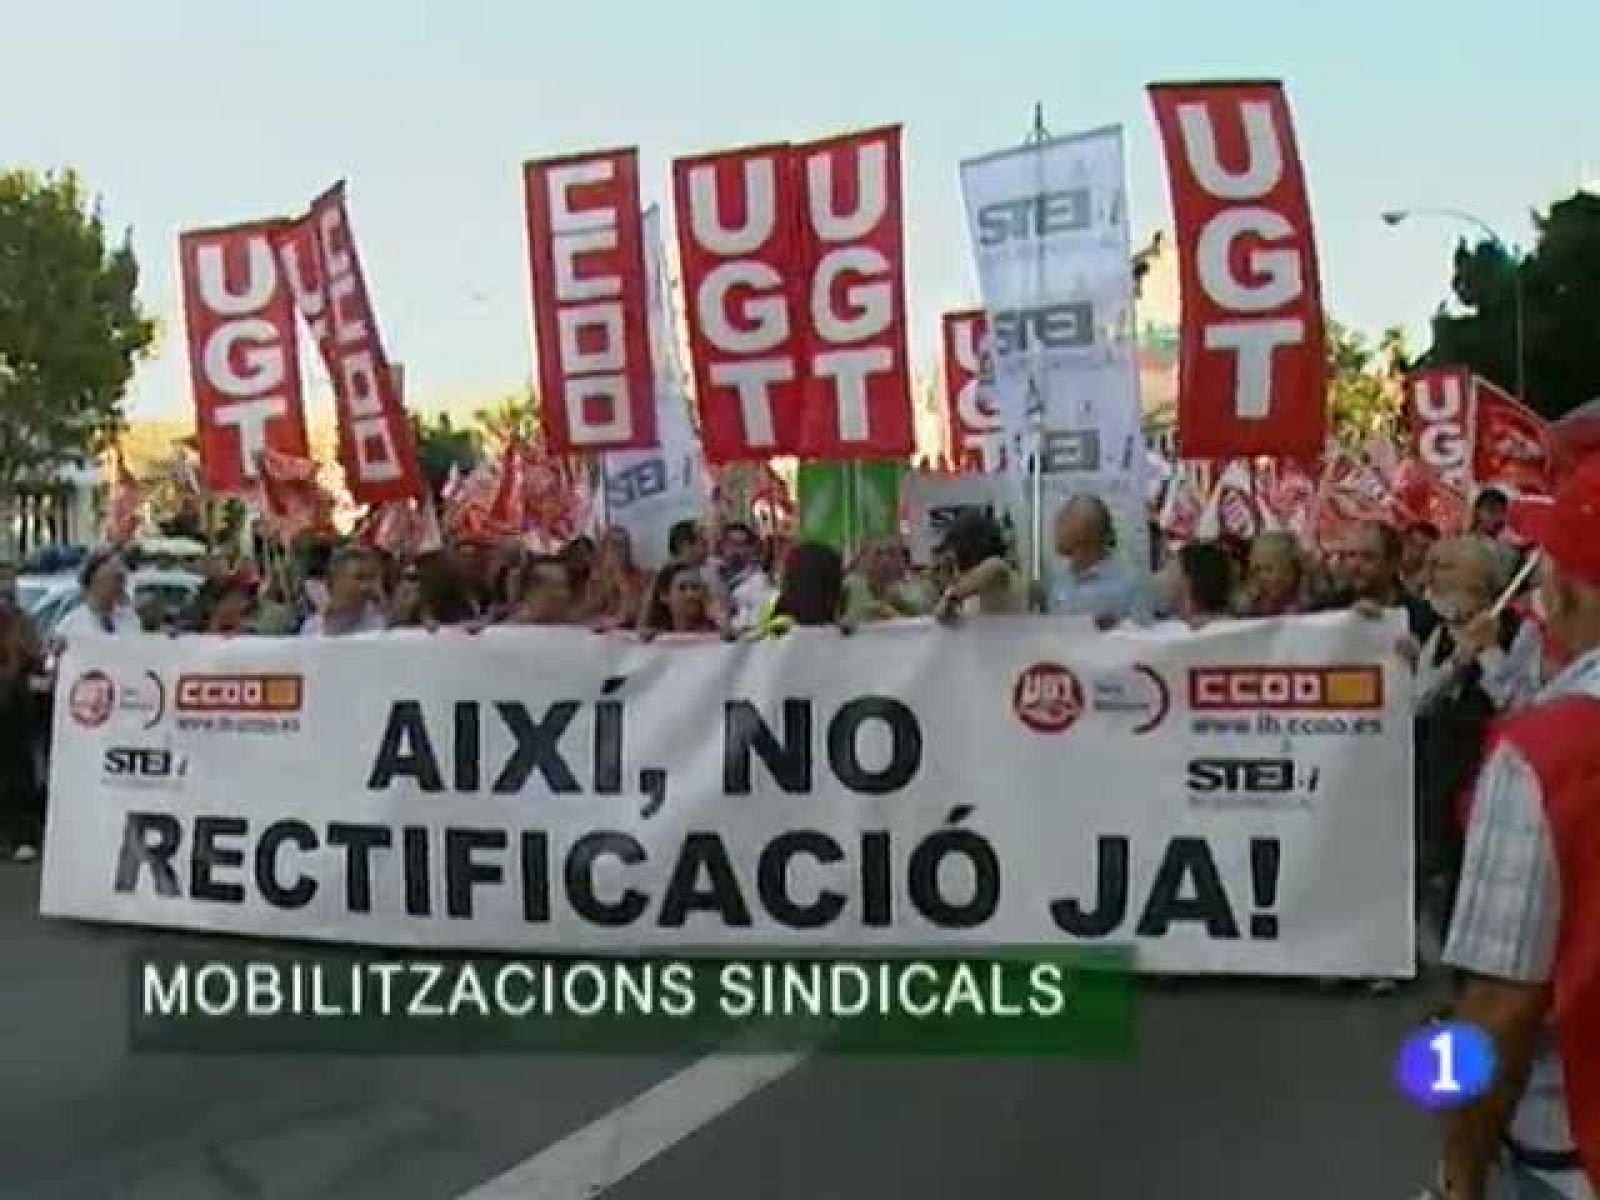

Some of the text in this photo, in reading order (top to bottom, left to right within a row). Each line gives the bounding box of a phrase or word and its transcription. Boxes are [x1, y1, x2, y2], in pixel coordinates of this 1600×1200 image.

[198, 235, 287, 478] UGT
[547, 160, 634, 444] CCOO
[689, 157, 796, 447] UGT
[806, 142, 893, 442] UGT
[1175, 100, 1303, 419] UGT
[367, 677, 923, 818] AIXÍ, NO
[1200, 675, 1322, 704] CCOO
[114, 804, 1281, 940] RECTIFICACIÓ JA!
